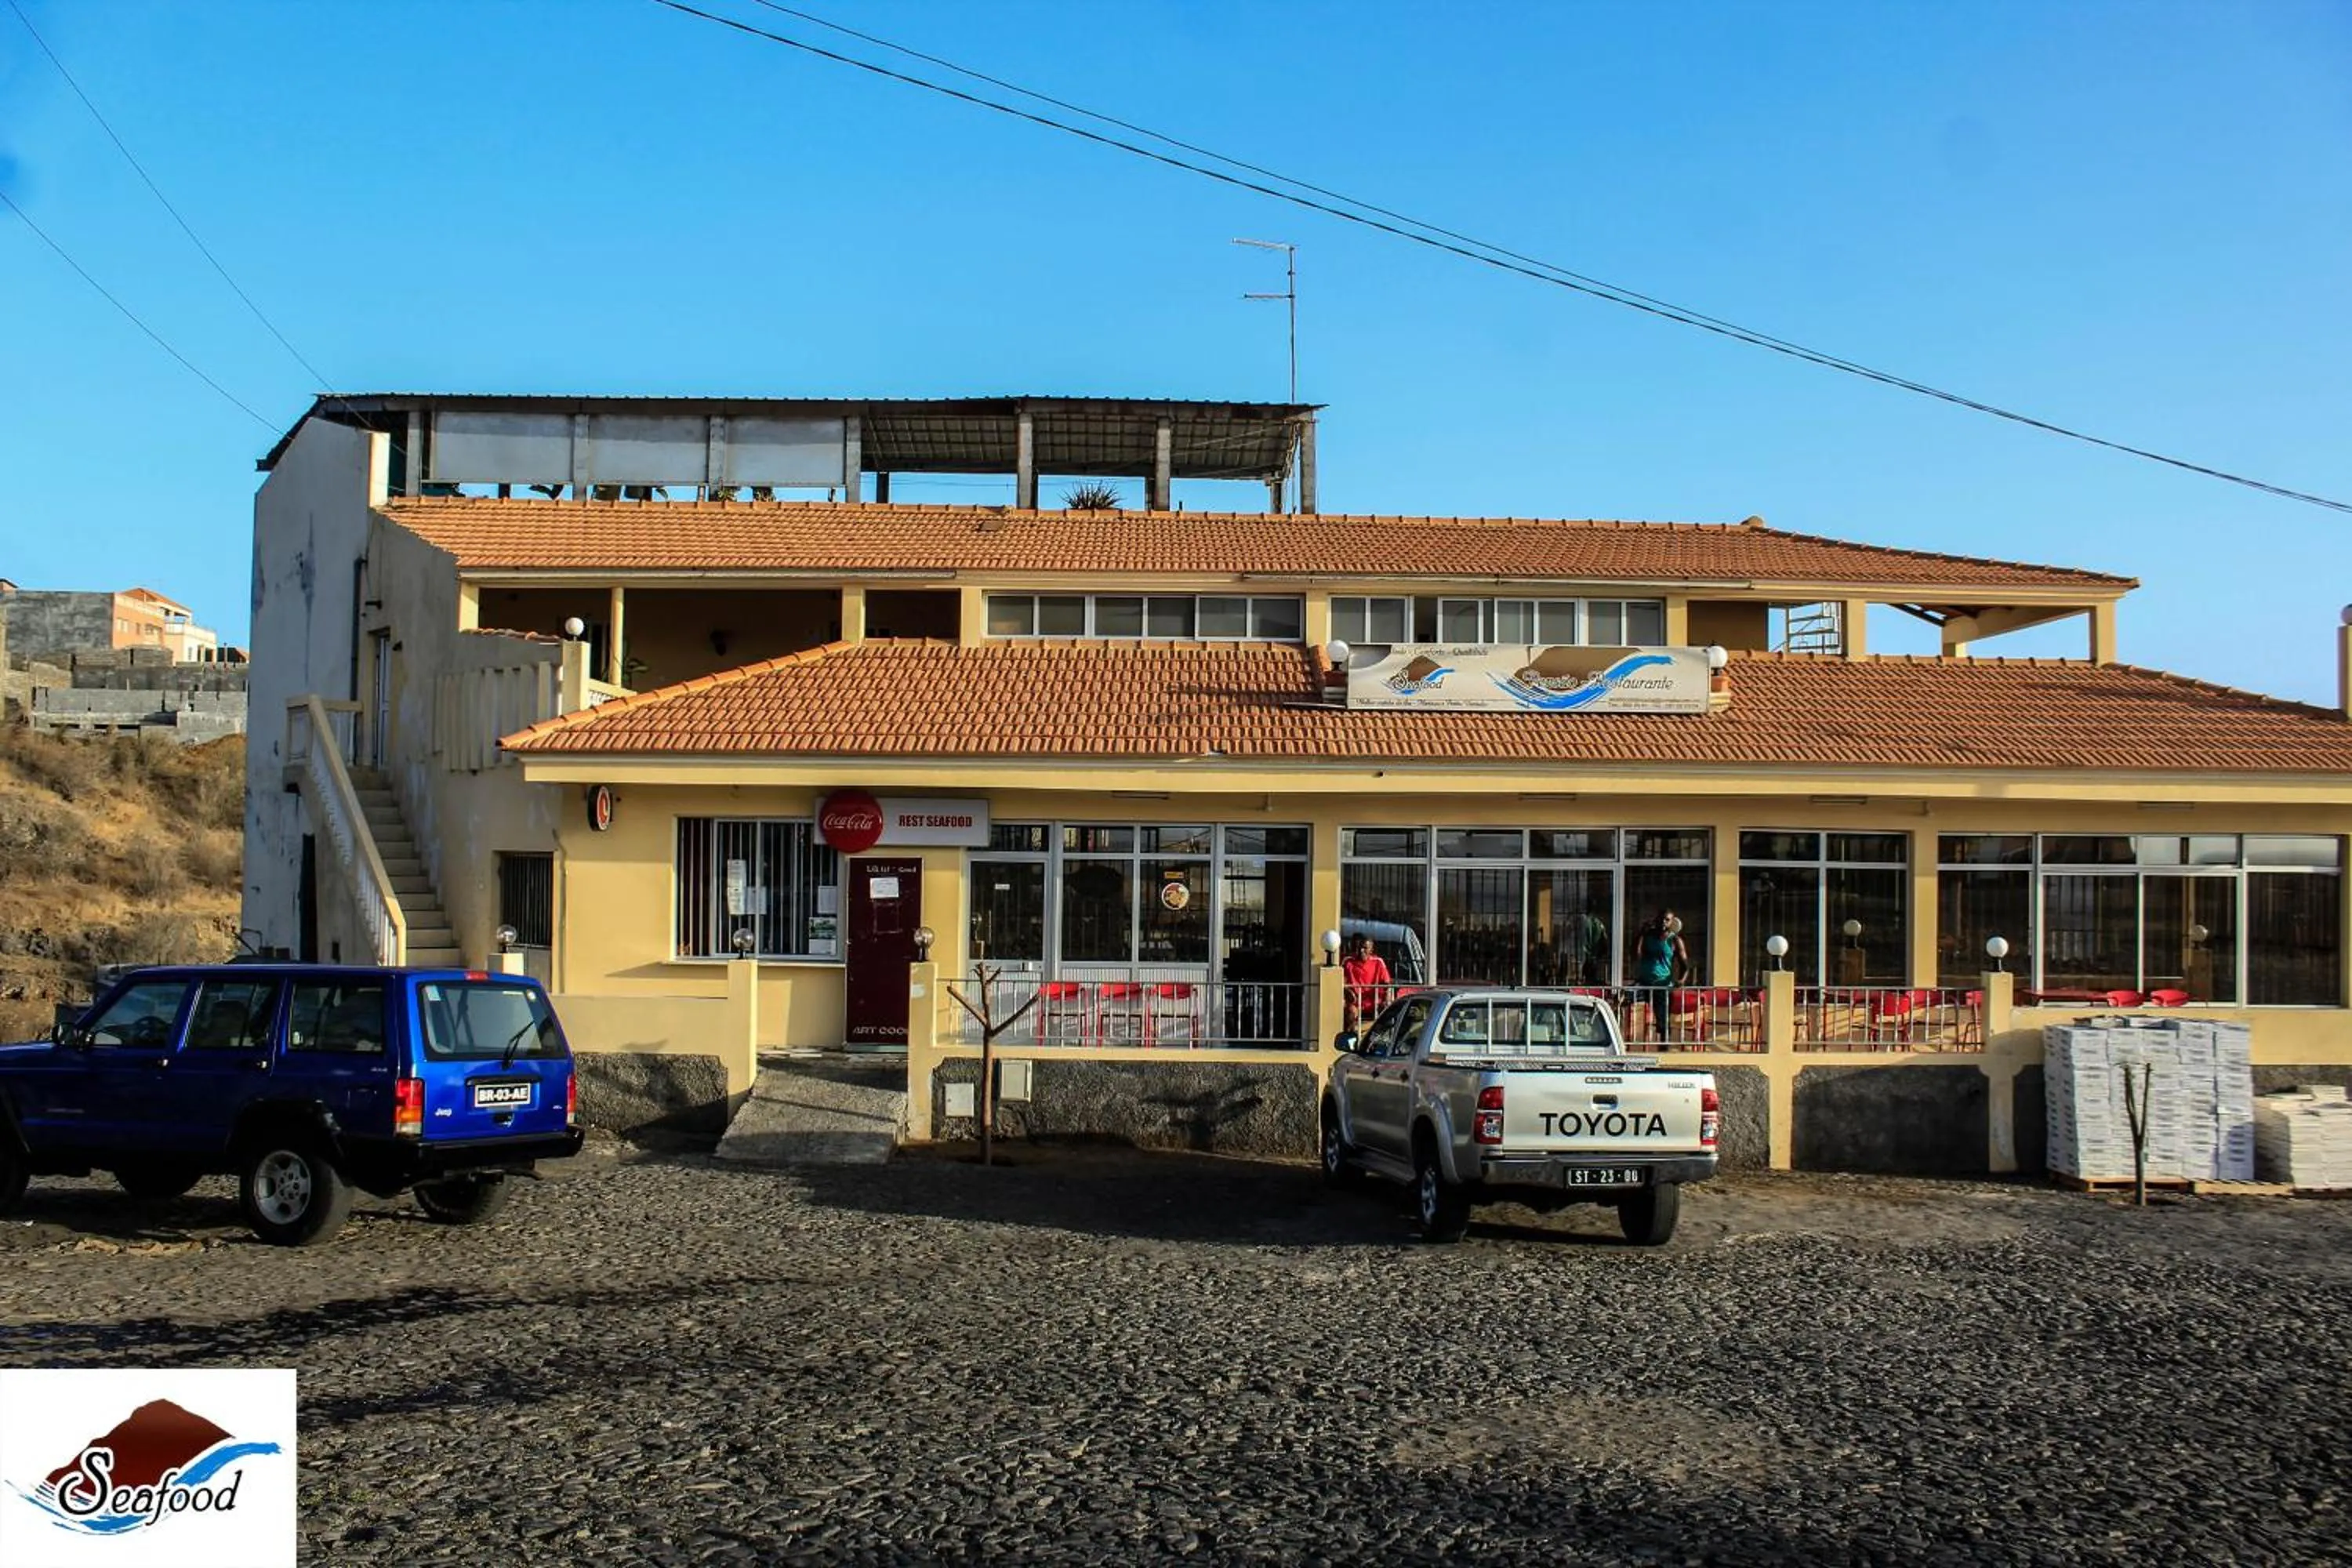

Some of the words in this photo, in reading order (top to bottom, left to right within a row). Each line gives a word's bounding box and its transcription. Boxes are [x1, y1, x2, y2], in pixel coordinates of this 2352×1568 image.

[823, 813, 876, 830] Coca-Cola
[926, 815, 973, 828] SEAFOOD
[1539, 1112, 1667, 1137] TOYOTA
